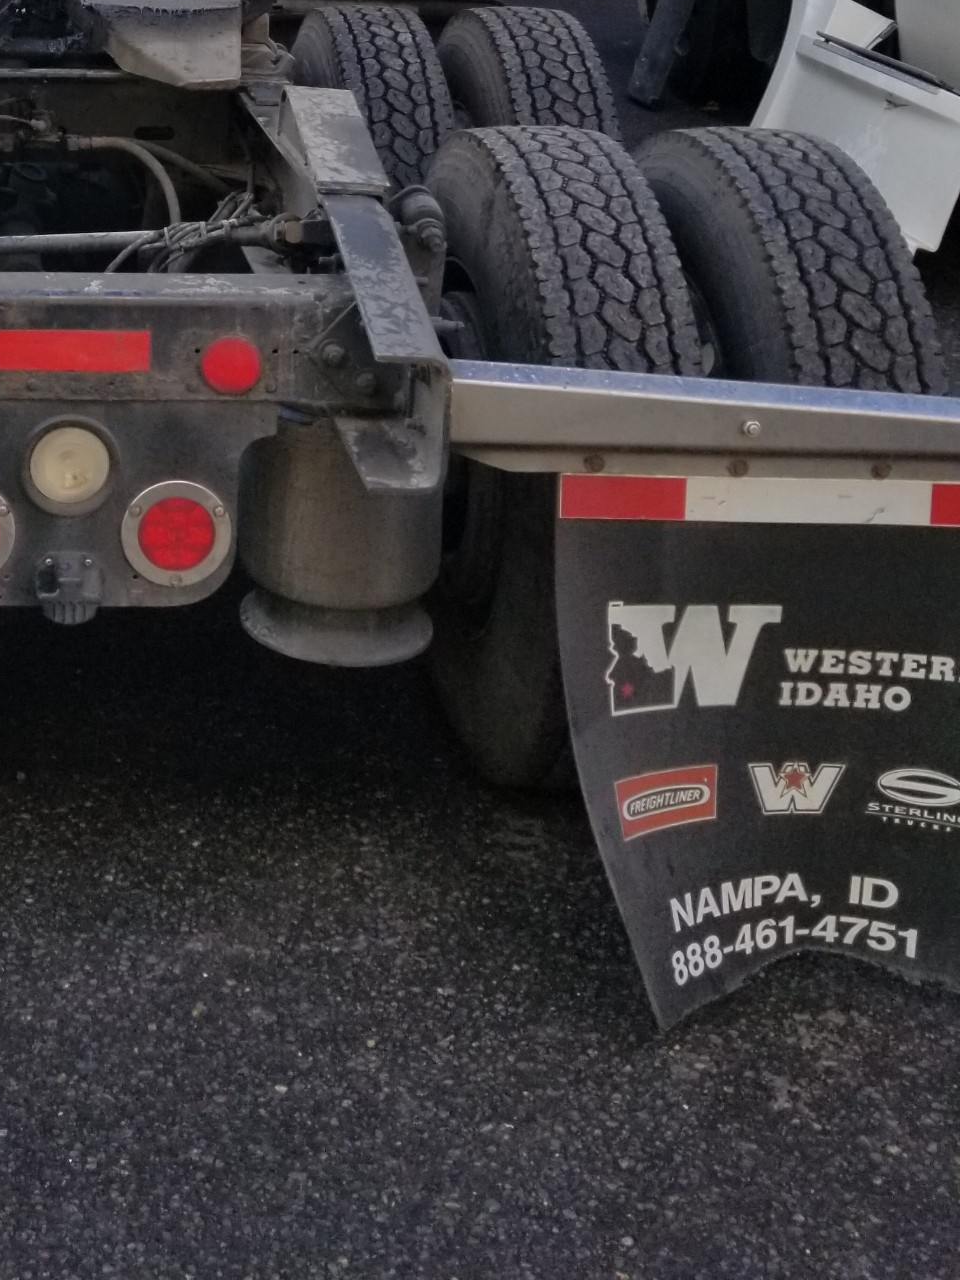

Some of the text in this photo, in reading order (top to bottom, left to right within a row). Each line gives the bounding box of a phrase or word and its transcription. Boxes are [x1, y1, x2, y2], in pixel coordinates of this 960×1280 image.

[784, 648, 960, 683] WESTER
[778, 681, 911, 712] IDAHO
[630, 789, 701, 814] FREIGHTLINER
[868, 802, 960, 825] STERLIN
[669, 873, 899, 932] NAMPA, ID
[671, 915, 918, 986] 888-461-4751
